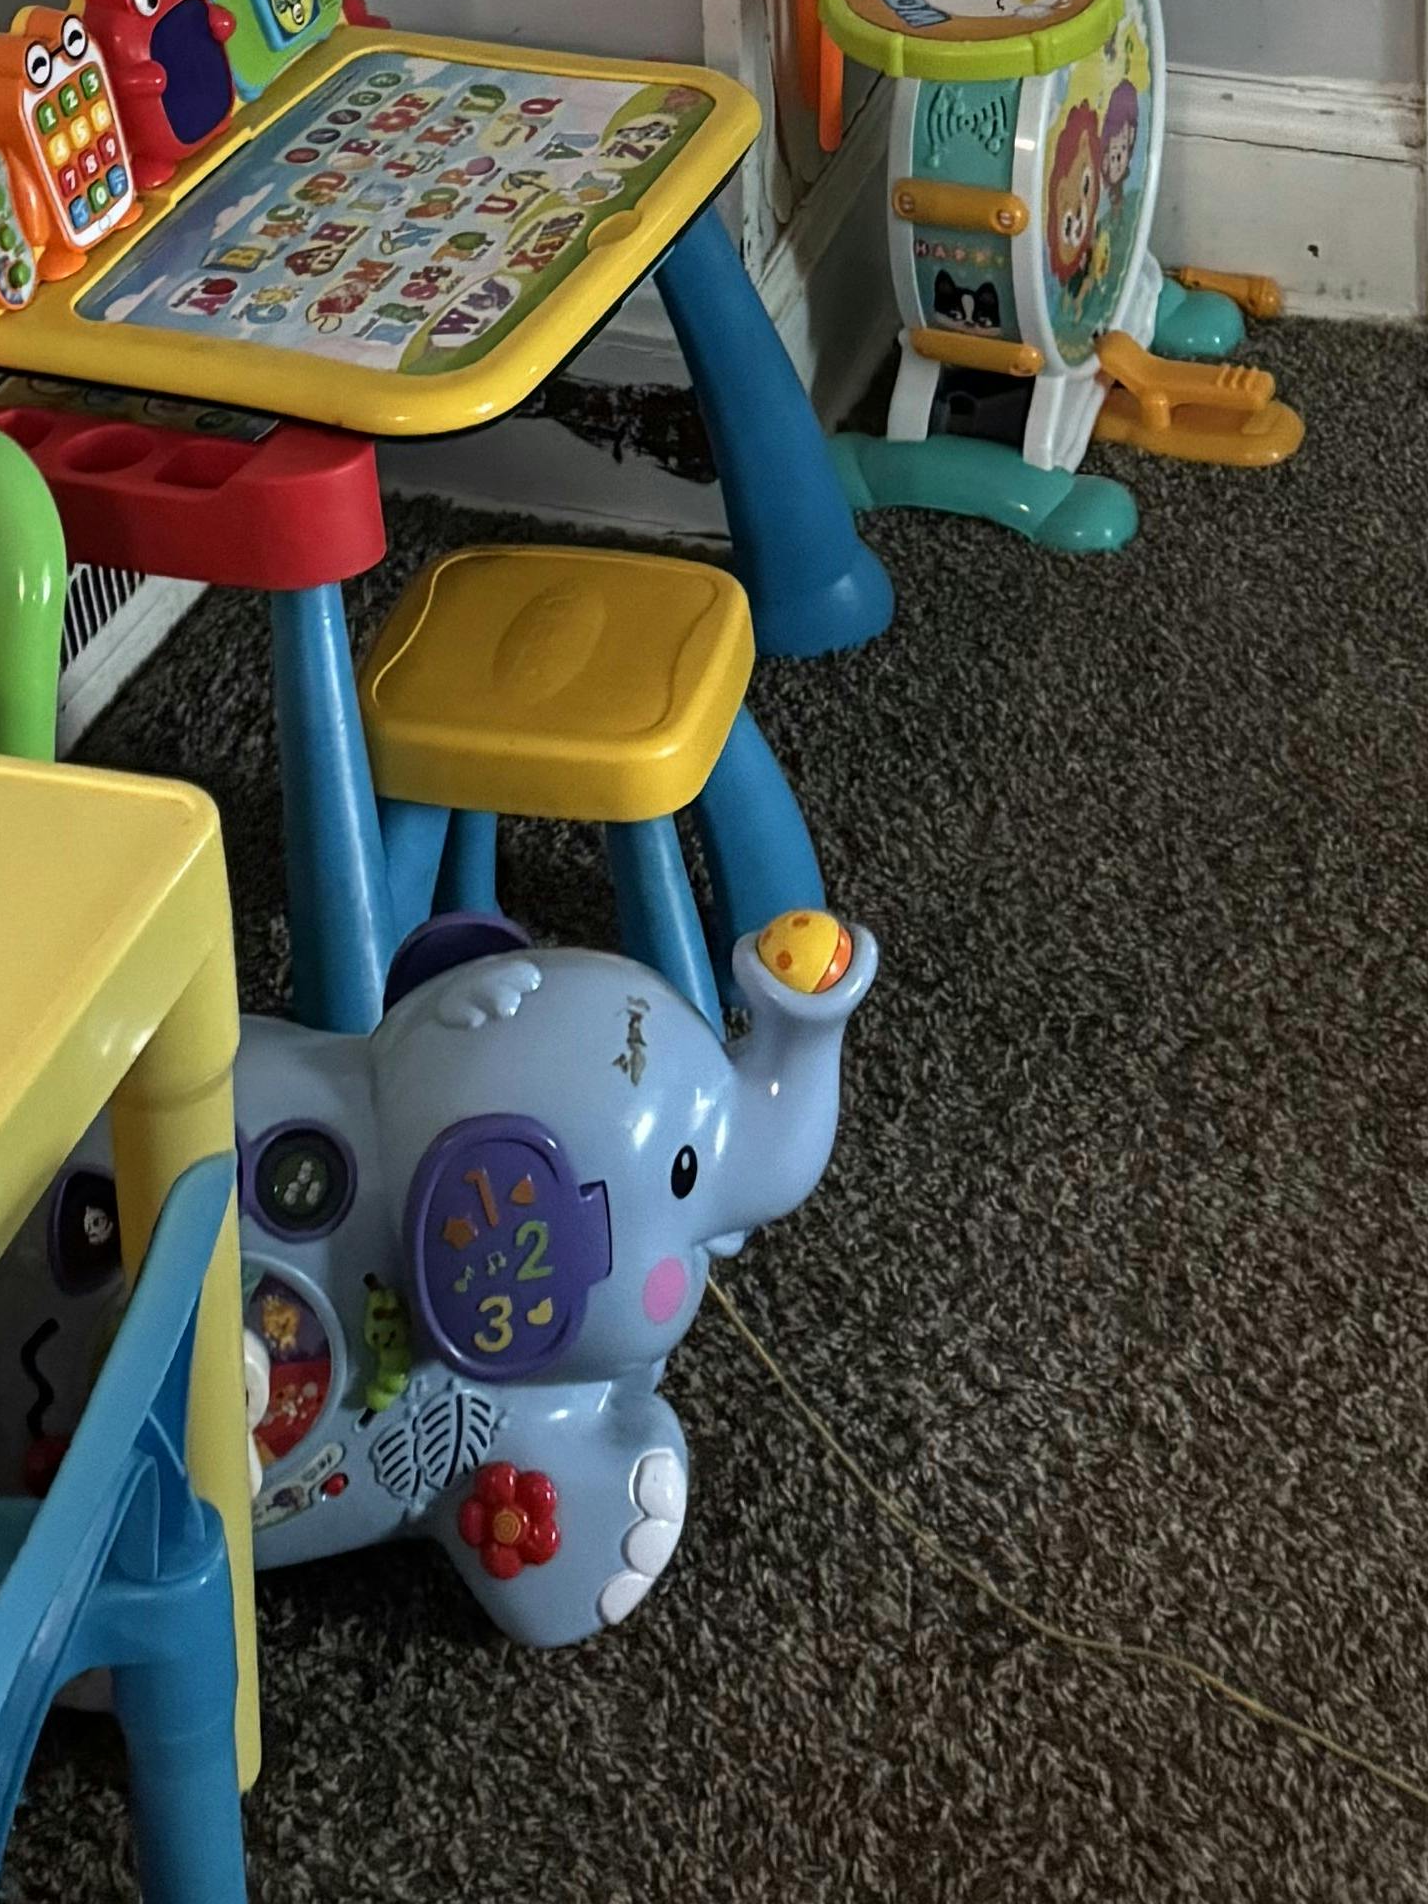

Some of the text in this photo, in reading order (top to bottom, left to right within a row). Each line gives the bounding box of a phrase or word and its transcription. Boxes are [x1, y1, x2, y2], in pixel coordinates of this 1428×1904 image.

[45, 73, 99, 125] 1 2 3
[64, 139, 116, 187] 7 8 9
[96, 187, 106, 205] 0
[473, 1168, 501, 1227] 1
[514, 1220, 556, 1282] 2
[473, 1295, 515, 1353] 3
